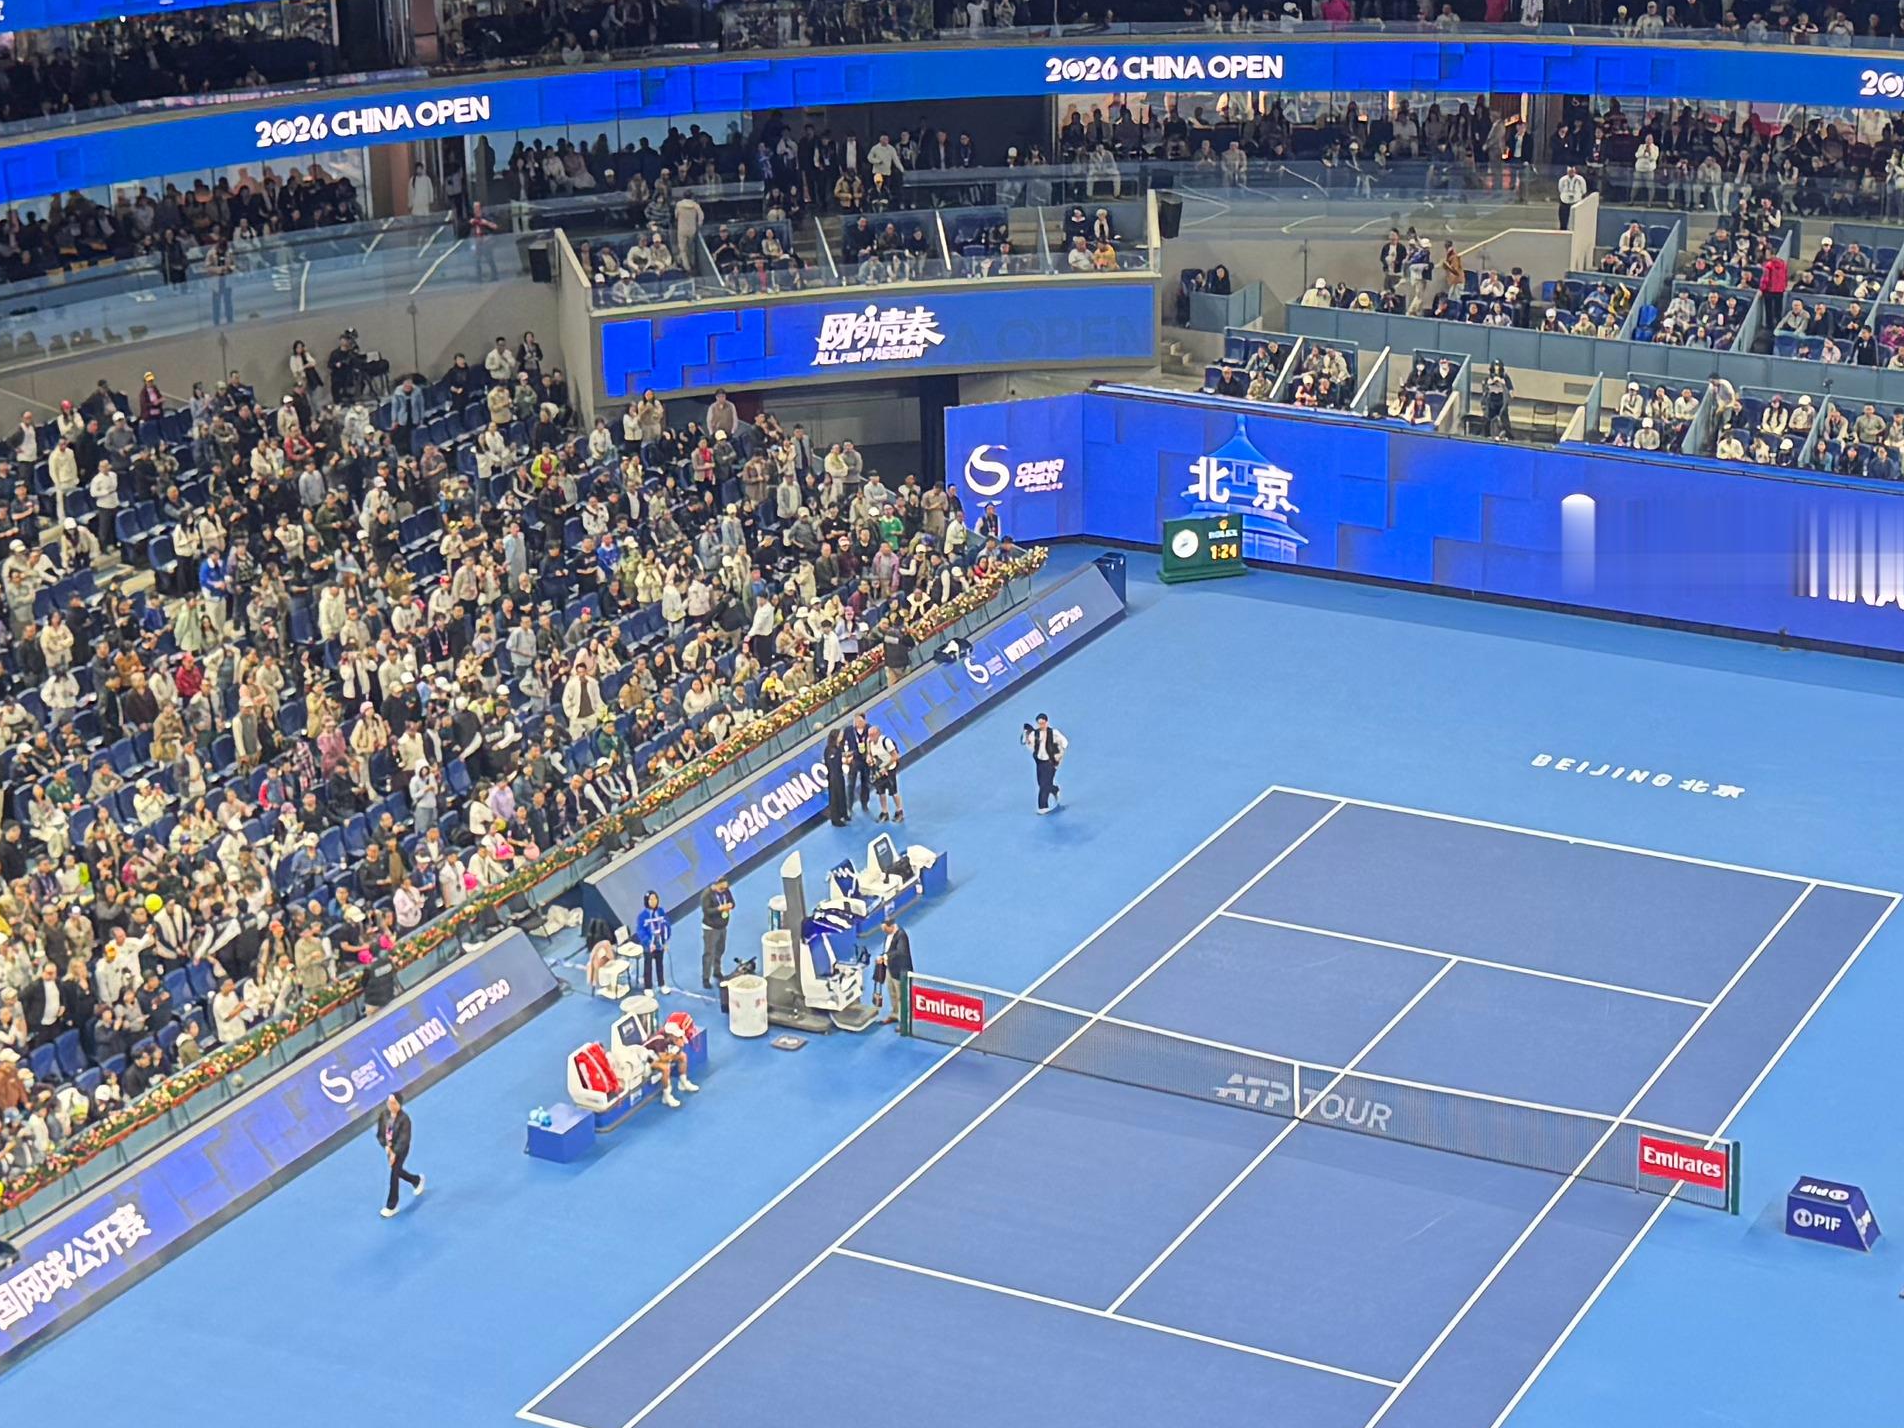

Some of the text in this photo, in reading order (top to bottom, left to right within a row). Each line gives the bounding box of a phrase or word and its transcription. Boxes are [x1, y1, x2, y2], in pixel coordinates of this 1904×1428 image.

[1122, 56, 1206, 81] CHINA
[1207, 55, 1284, 80] OPEN
[331, 104, 414, 137] CHINA
[415, 95, 491, 124] OPEN
[1187, 456, 1294, 512] 北京
[1530, 753, 1674, 788] BEIJING
[761, 773, 822, 820] CHINA
[915, 993, 982, 1023] Emirates
[1213, 1073, 1393, 1132] ATP TOUR
[1642, 1146, 1722, 1179] Emirates
[1813, 1213, 1843, 1232] PIF
